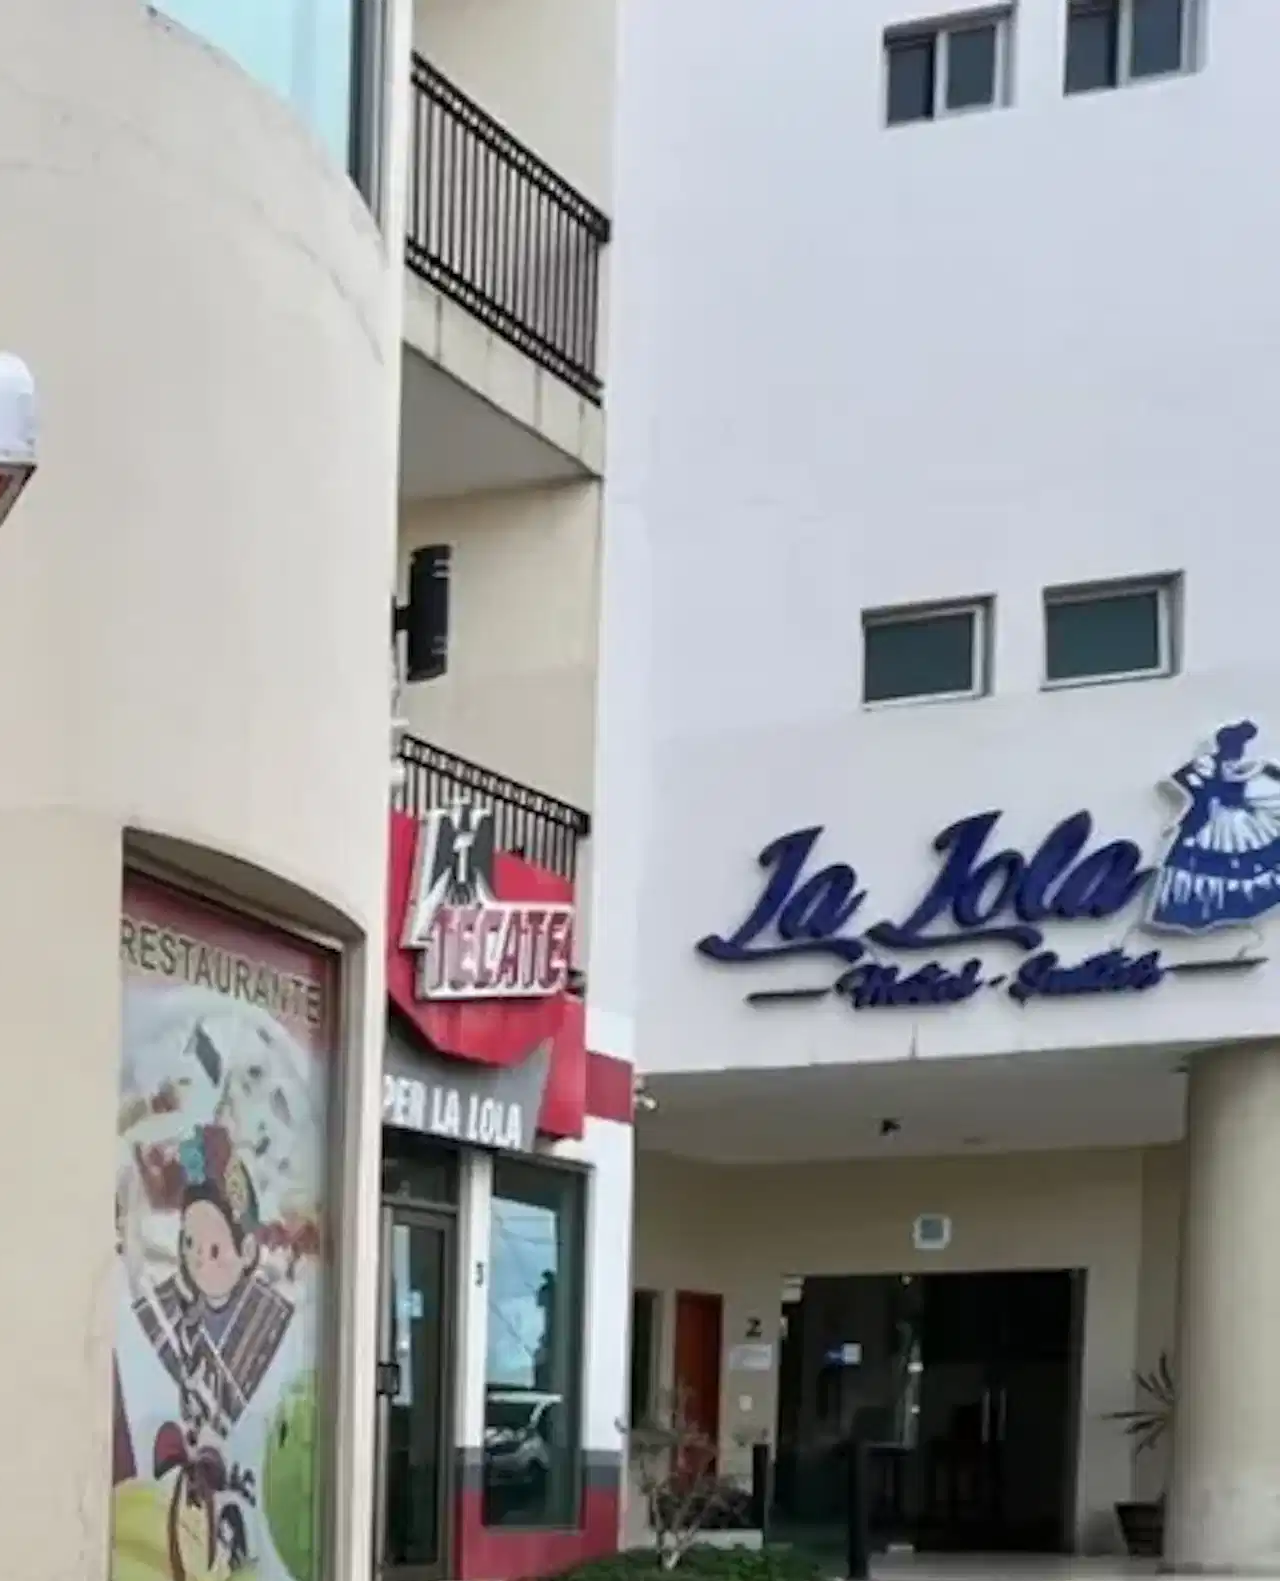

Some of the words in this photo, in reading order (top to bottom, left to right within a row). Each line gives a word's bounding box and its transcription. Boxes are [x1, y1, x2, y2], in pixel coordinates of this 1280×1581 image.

[695, 826, 868, 962] La
[864, 809, 1158, 950] Lola
[120, 918, 323, 1025] RESTAURANTE
[429, 908, 572, 990] TECATE
[431, 1084, 461, 1138] LA
[467, 1093, 523, 1150] LOLA
[745, 1315, 762, 1338] 2
